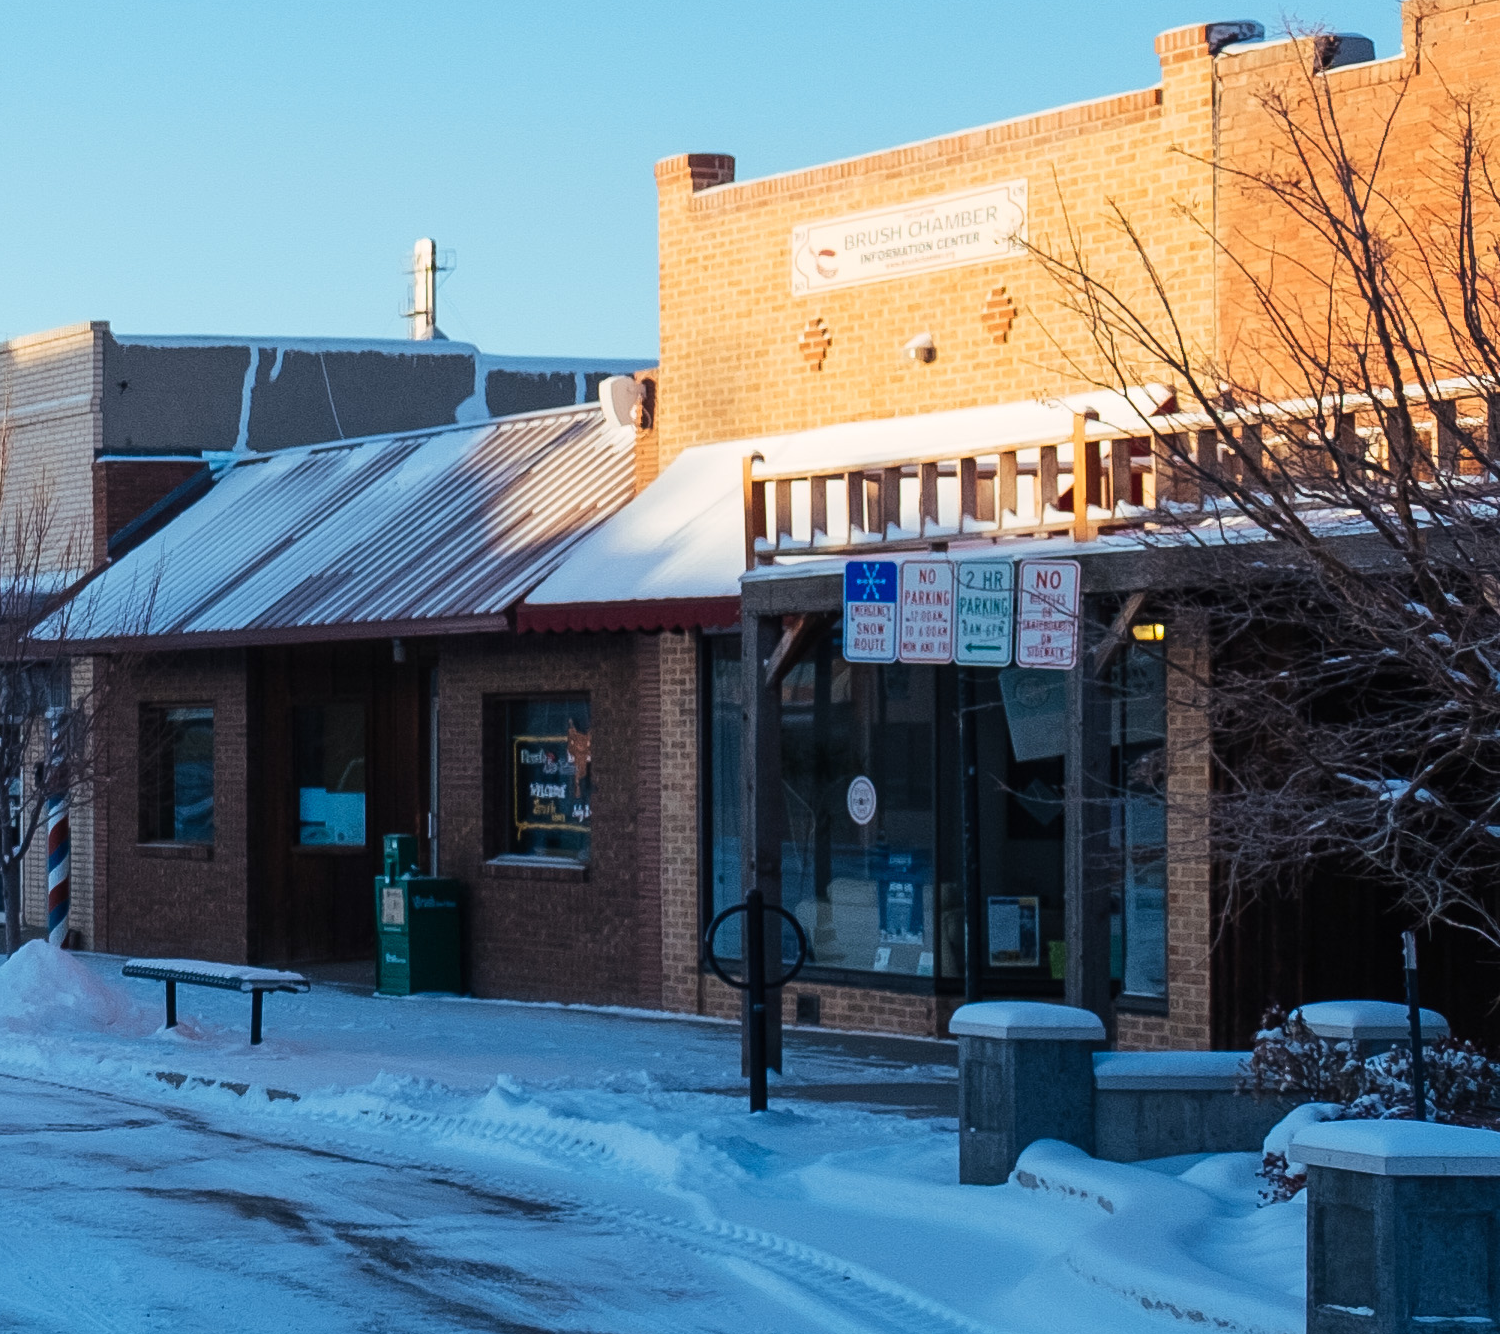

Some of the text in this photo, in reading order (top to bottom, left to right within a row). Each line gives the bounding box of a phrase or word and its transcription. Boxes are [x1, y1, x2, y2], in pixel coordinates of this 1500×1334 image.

[844, 205, 998, 250] BRUSH CHAMBER
[860, 231, 980, 265] INFORMATION CENTER
[919, 567, 937, 585] NO
[966, 570, 1004, 588] 2 HR
[1035, 570, 1062, 590] NO
[904, 589, 950, 607] PARKING
[959, 595, 1009, 617] PARKING
[856, 621, 886, 636] SNOW
[853, 637, 887, 652] ROUTE
